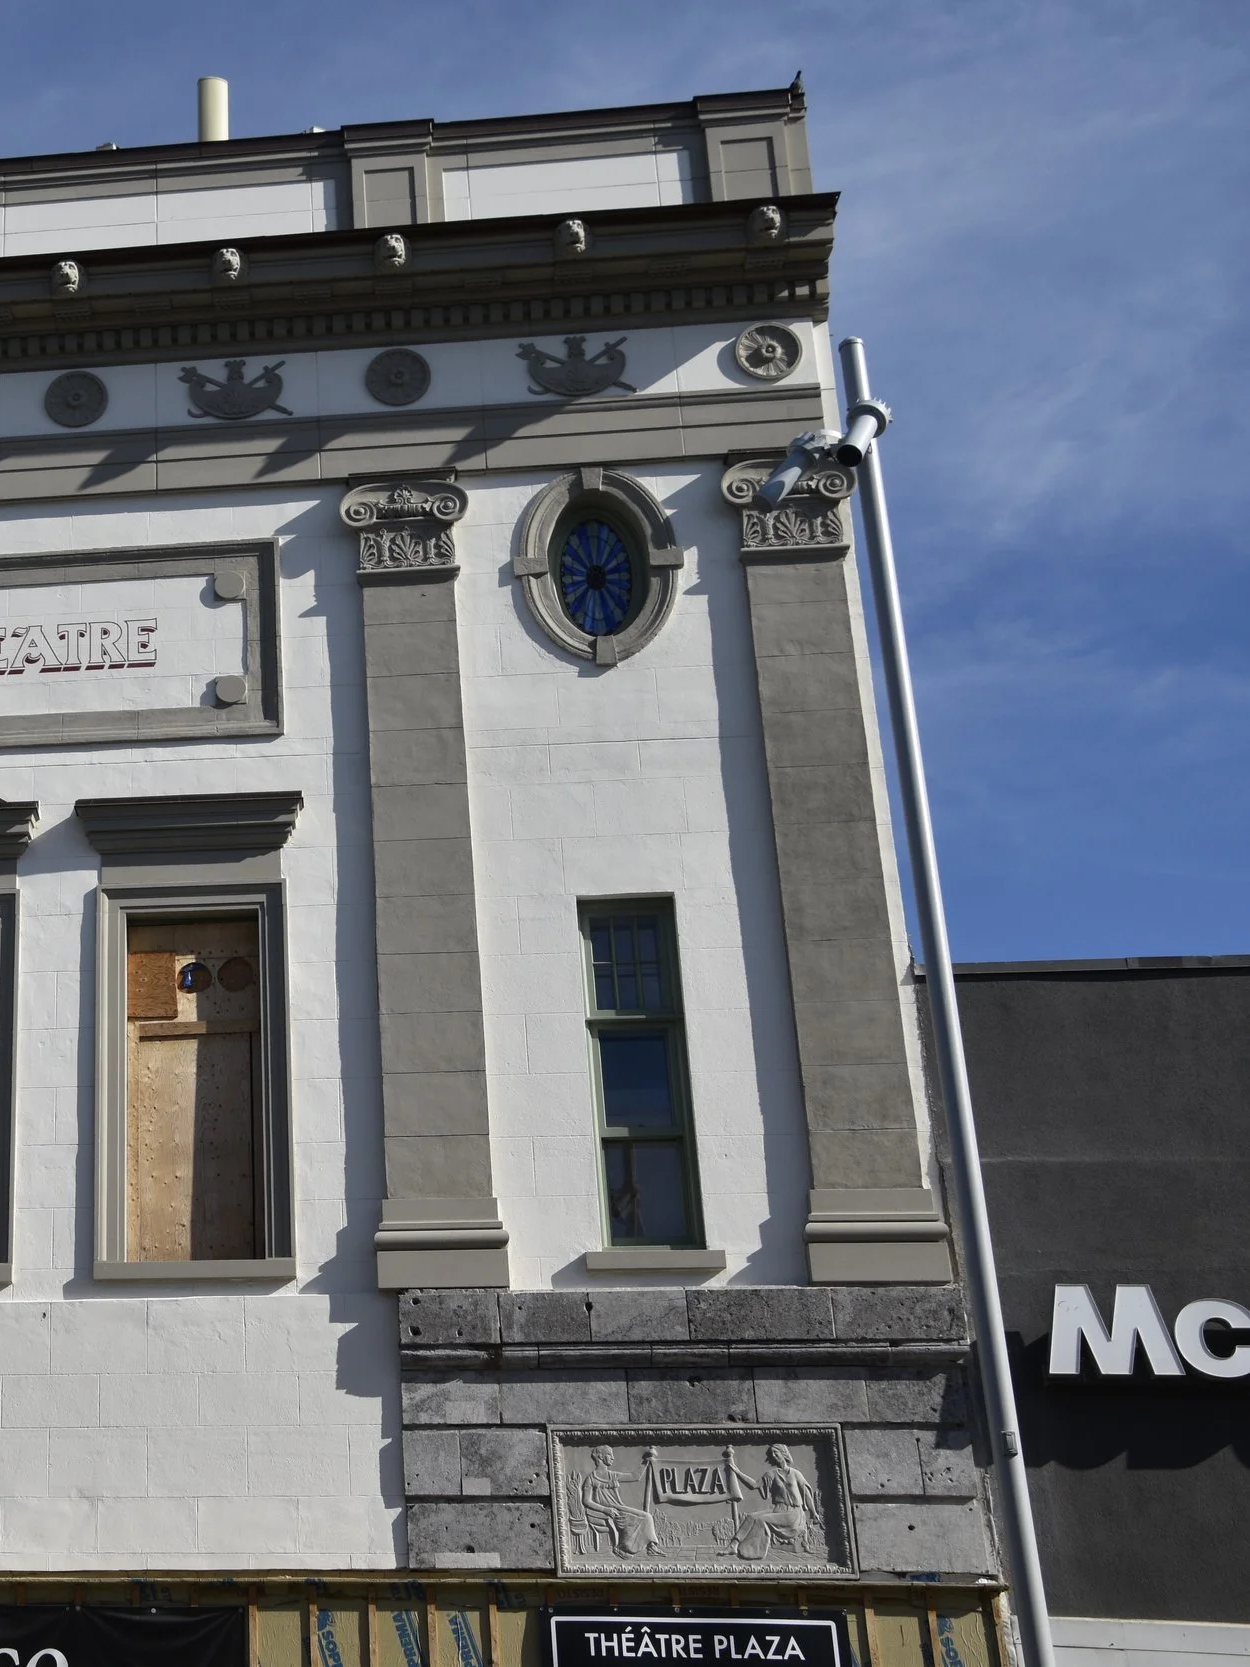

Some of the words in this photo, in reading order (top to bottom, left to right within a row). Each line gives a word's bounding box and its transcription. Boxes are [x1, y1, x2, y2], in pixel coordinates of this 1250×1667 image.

[660, 1467, 726, 1494] PLAZA
[584, 1626, 703, 1658] THÉÂTRE
[713, 1634, 806, 1660] PLAZA
